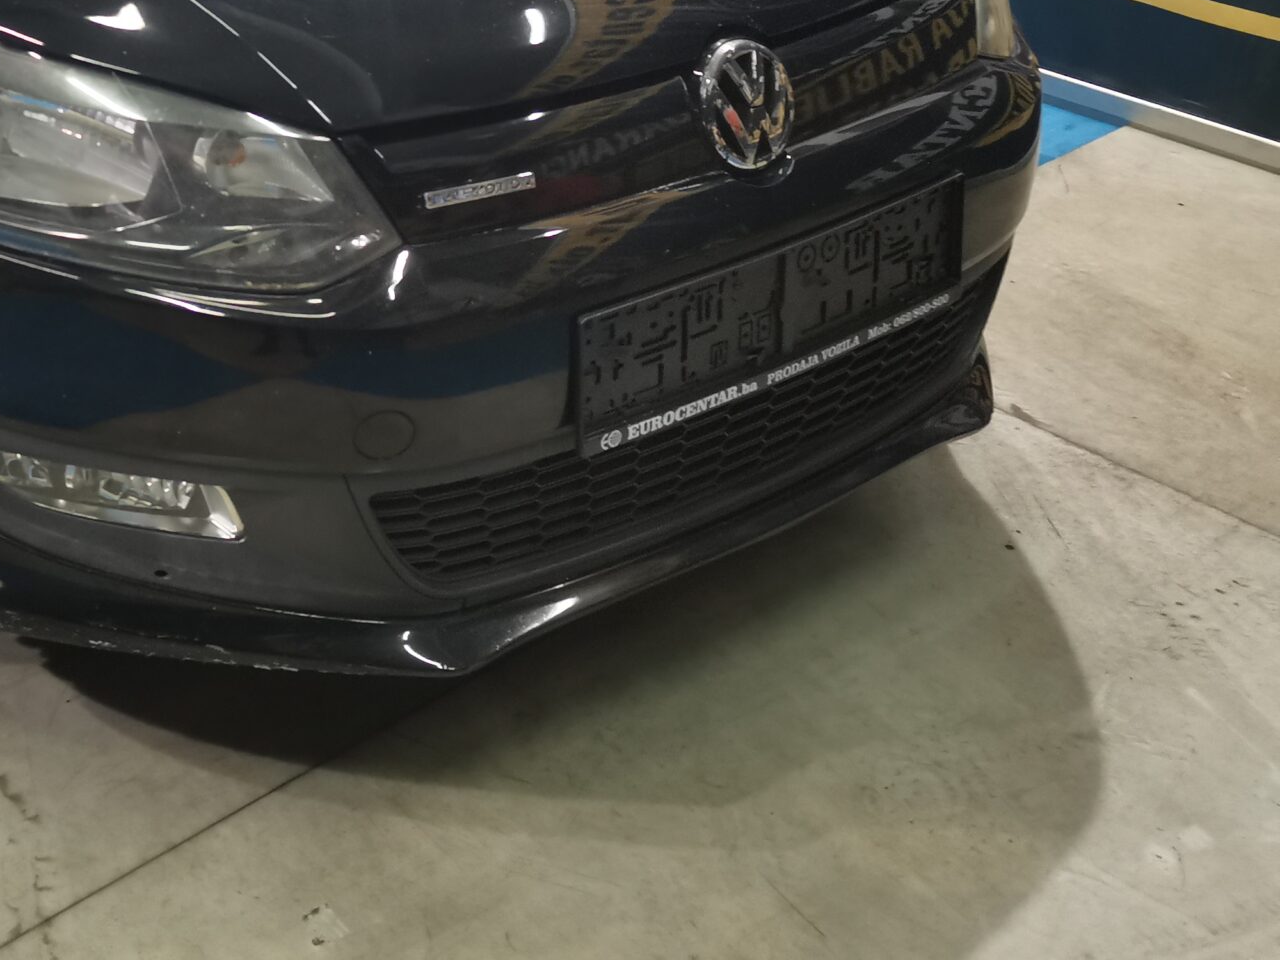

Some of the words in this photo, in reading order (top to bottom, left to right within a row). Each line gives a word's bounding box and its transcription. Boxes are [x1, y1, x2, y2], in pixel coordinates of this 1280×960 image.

[627, 382, 758, 440] EUROCENTAR.ba
[767, 354, 820, 385] PRODAJA
[821, 336, 860, 361] VOZILA
